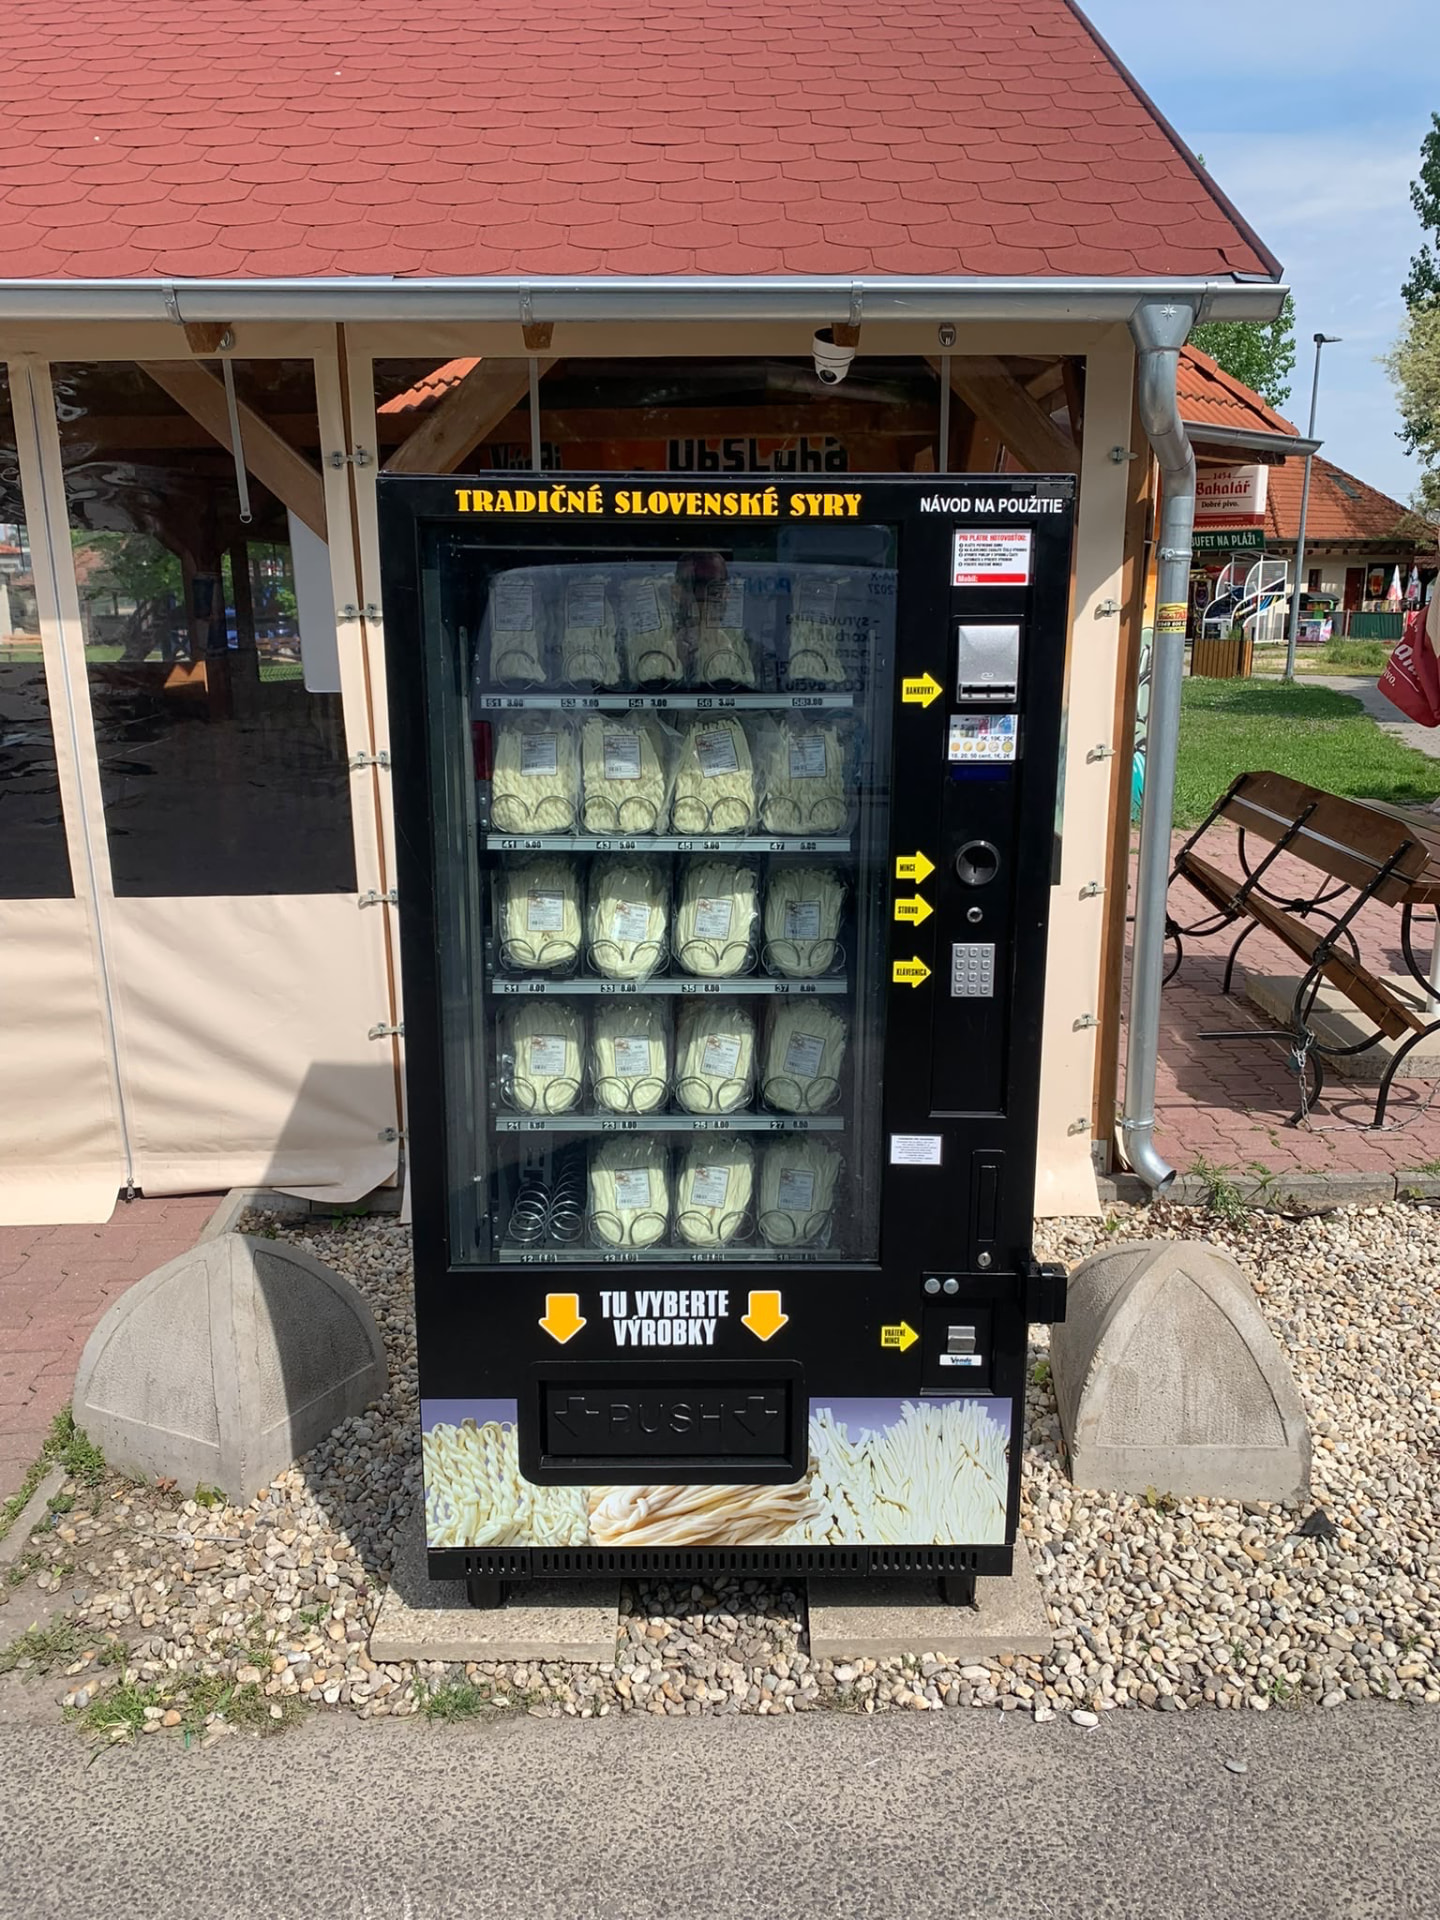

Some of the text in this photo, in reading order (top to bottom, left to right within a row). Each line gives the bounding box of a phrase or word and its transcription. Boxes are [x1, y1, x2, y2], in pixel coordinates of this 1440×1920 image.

[455, 484, 862, 516] TRADIČNÉ SLOVENSKÉ SYRY
[920, 494, 1063, 513] NÁVOD NA POUŽITIE
[1201, 499, 1221, 508] Dobré
[1217, 535, 1229, 546] NA
[1231, 532, 1255, 546] PLÁŽI
[906, 686, 934, 695] BANKOVKY
[900, 864, 916, 872] MINCE
[898, 906, 918, 914] STORNO
[600, 1290, 729, 1319] TU VYBERTE
[613, 1315, 717, 1347] VÝROBKY
[609, 1403, 724, 1433] PUSH
